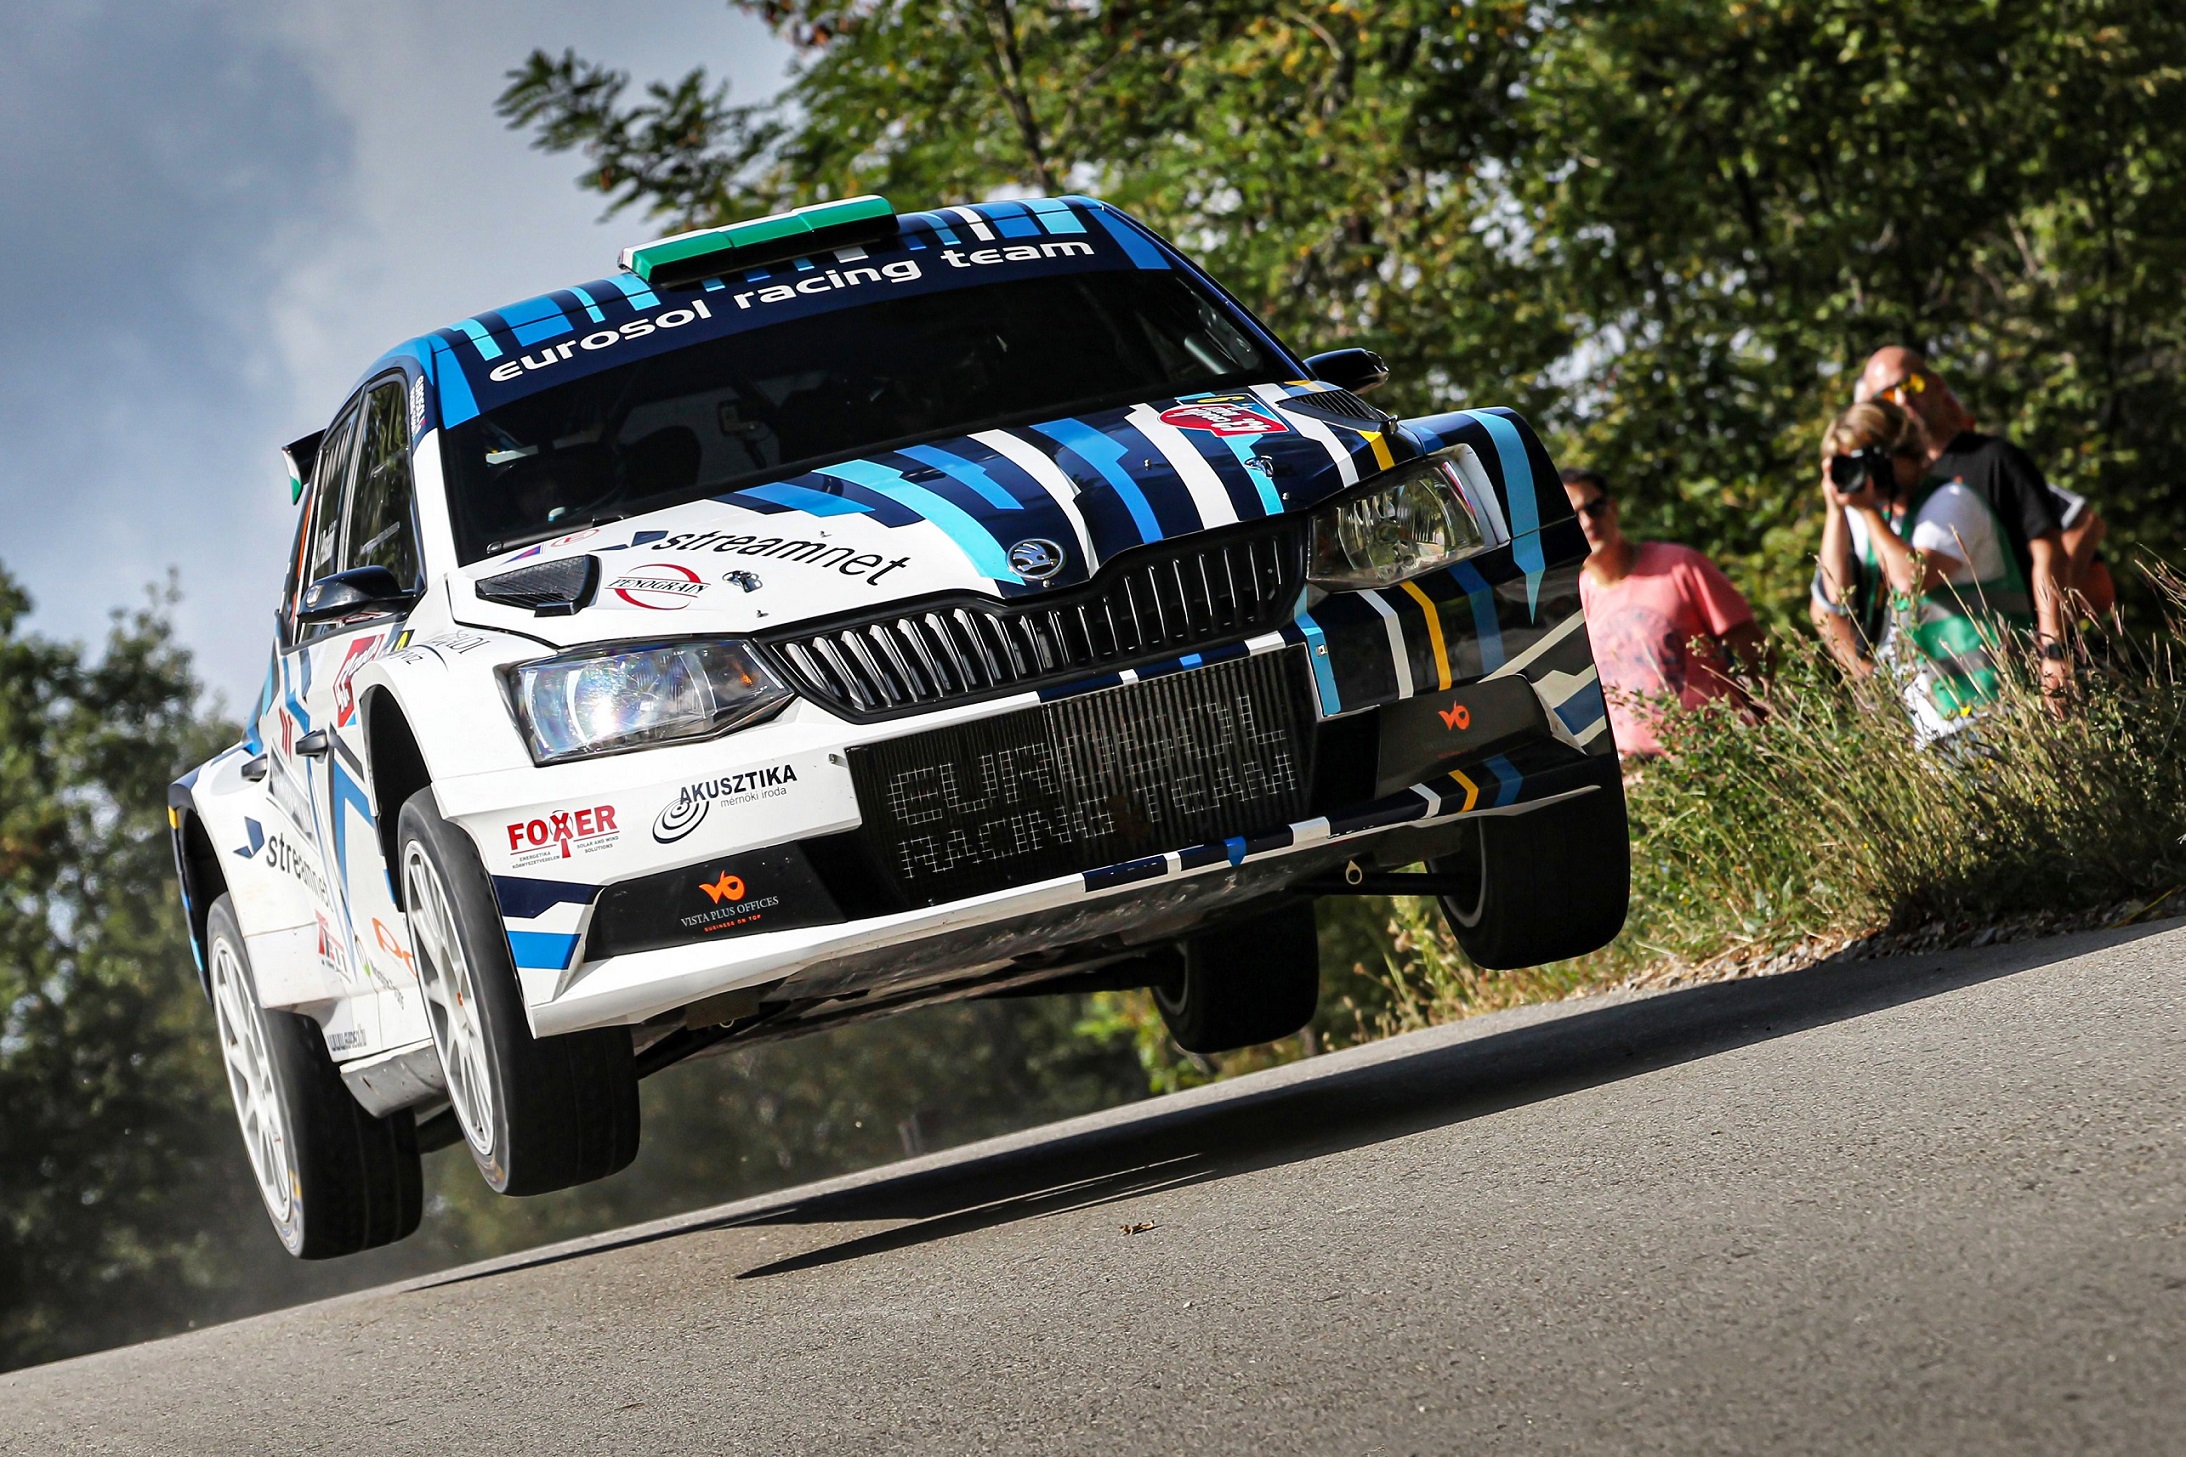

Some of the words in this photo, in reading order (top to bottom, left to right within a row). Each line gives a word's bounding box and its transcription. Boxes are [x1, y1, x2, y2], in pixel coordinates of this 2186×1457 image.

[489, 299, 711, 383] eurosol
[733, 259, 922, 311] racing
[940, 238, 1095, 269] team
[652, 530, 911, 586] streamnet
[679, 764, 798, 805] AKUSZTIKA
[720, 791, 759, 808] mérnöki
[760, 785, 788, 799] iroda
[1132, 751, 1297, 824] TEAM
[507, 805, 619, 852] FOXER
[584, 843, 613, 854] SOLUTIONS
[681, 913, 710, 927] VISTA
[711, 907, 736, 920] PLUS
[736, 896, 779, 913] OFFICES
